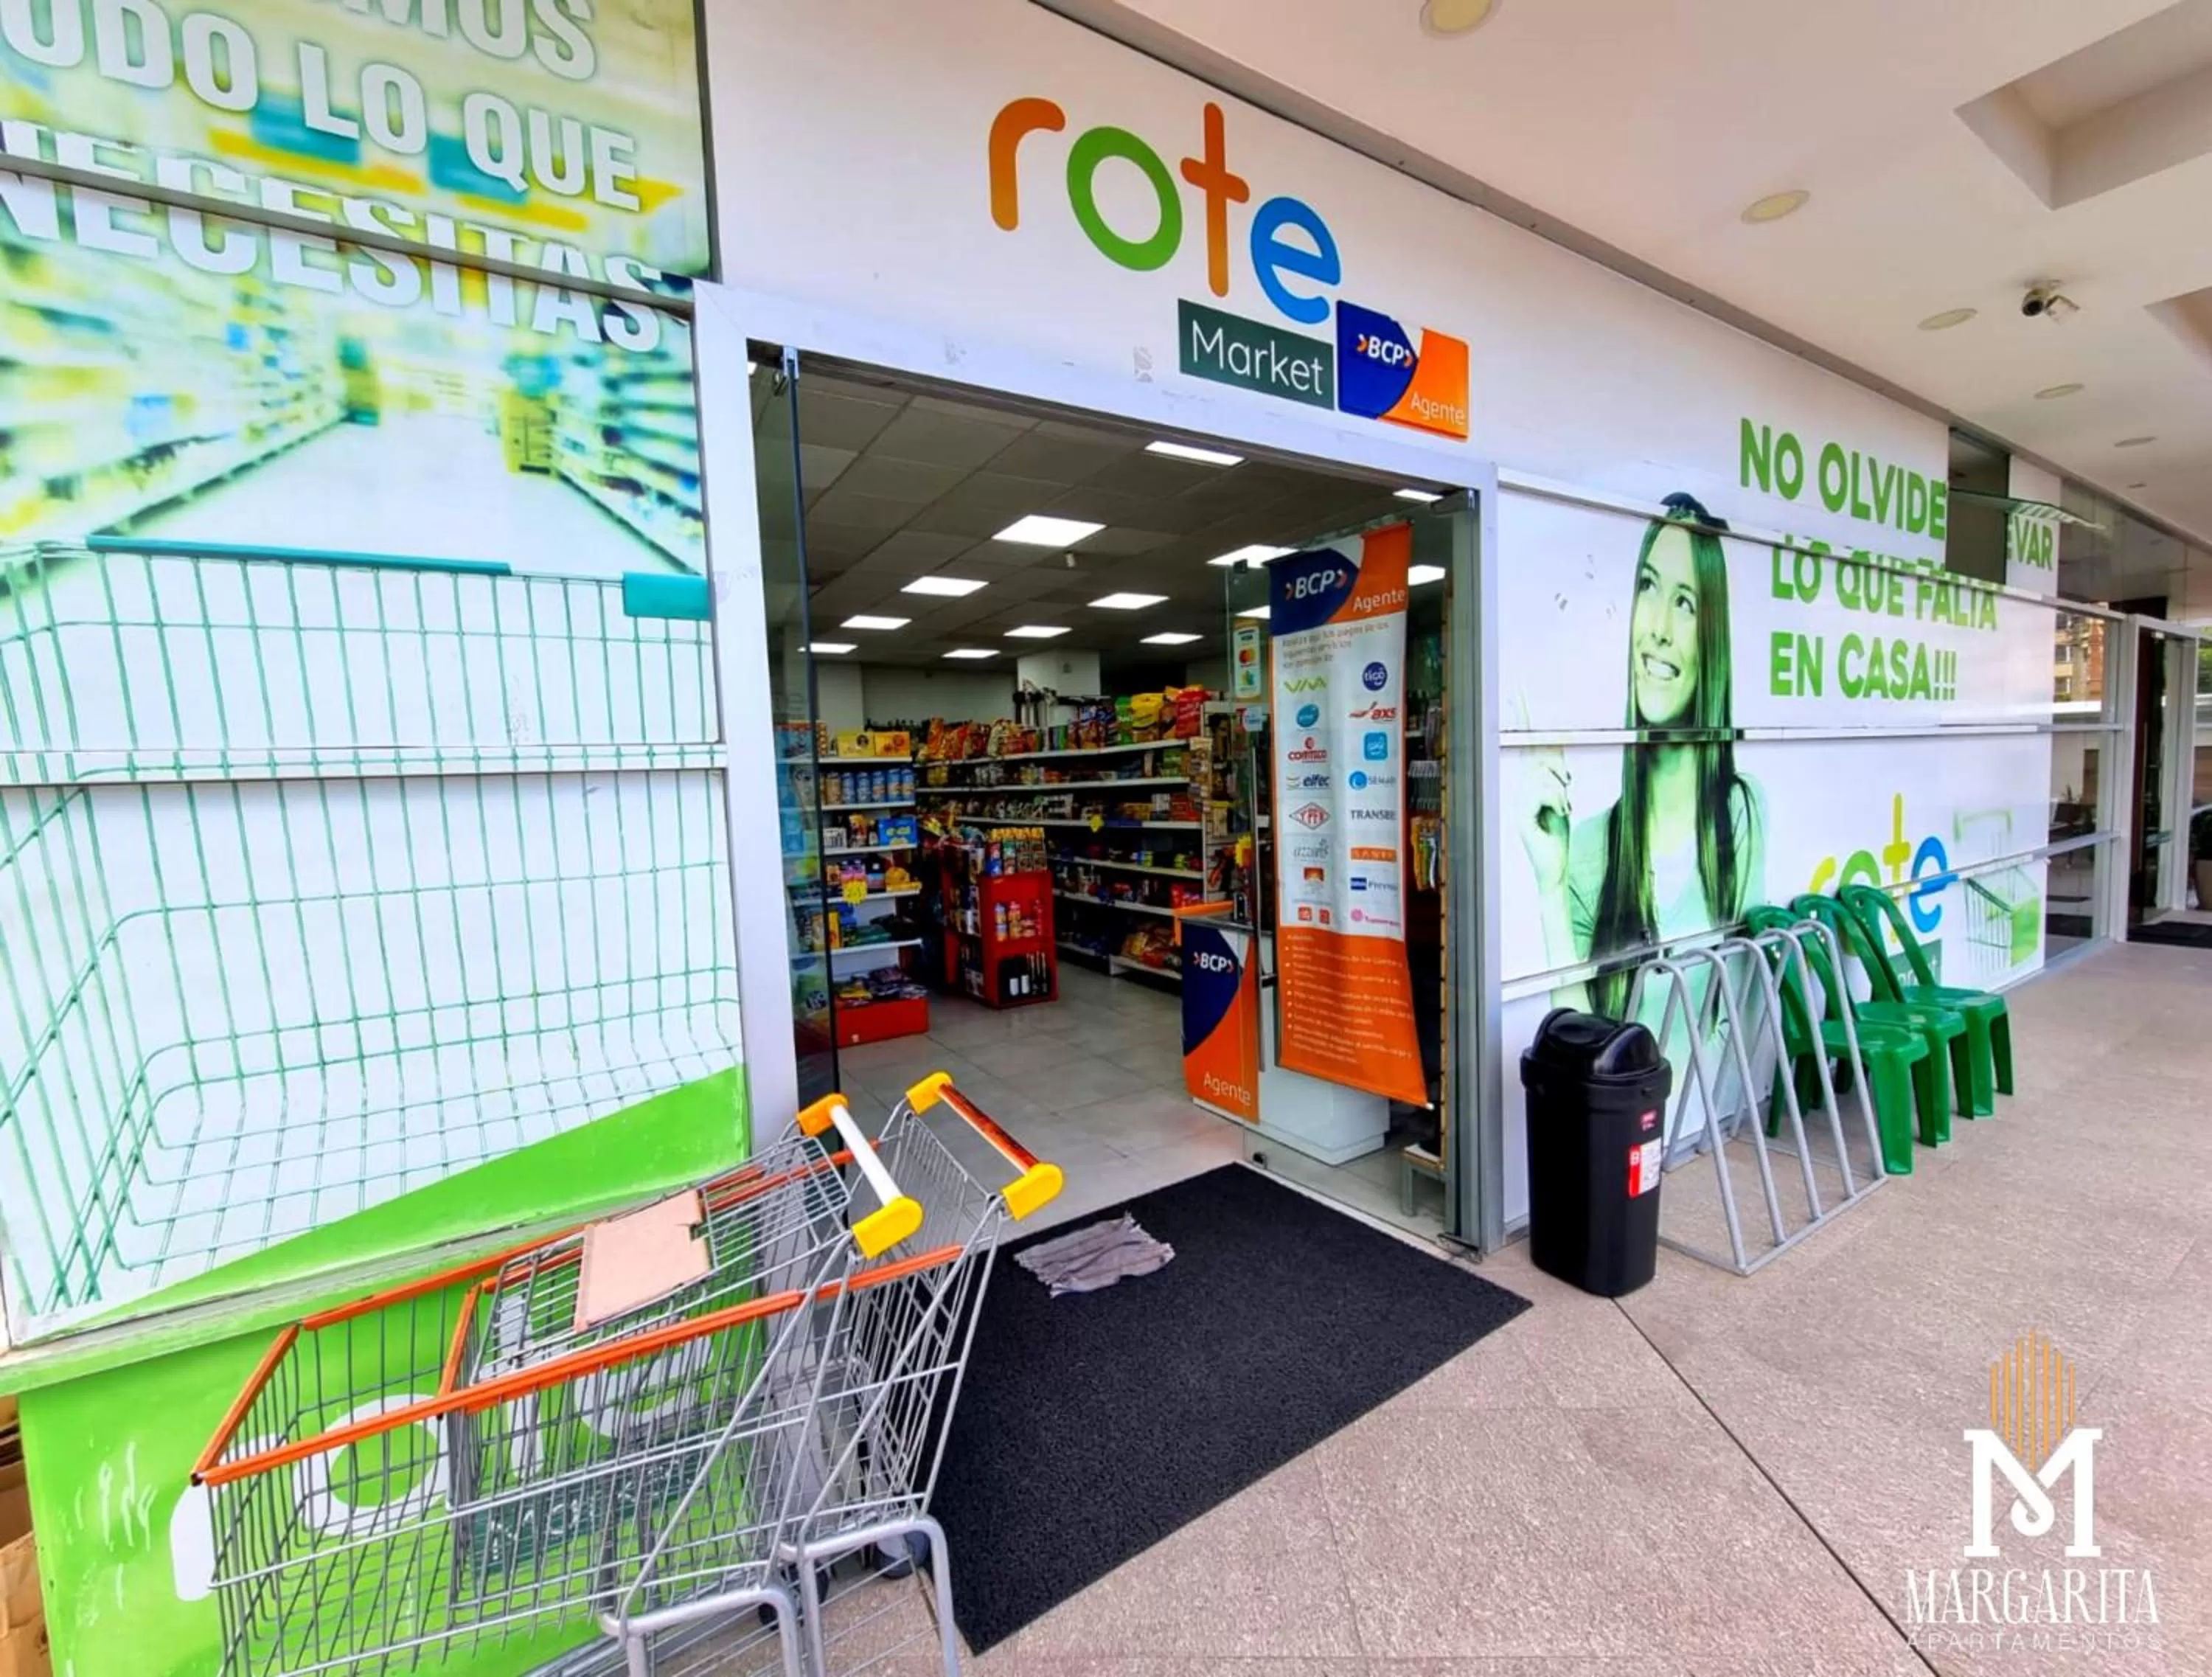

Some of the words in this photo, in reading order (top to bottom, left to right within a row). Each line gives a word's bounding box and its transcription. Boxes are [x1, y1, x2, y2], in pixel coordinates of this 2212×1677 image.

[299, 41, 428, 155] LO
[462, 94, 641, 211] QUE
[0, 119, 663, 353] NECESITAS
[989, 97, 1342, 324] rote
[1192, 319, 1324, 396] Market
[1368, 336, 1406, 367] BCP
[1411, 392, 1466, 427] Agente
[1740, 417, 1804, 501] NO
[1818, 442, 1947, 541] OLVIDE
[1295, 569, 1335, 599] BCP
[1352, 589, 1405, 613] Agente
[1772, 534, 1830, 604] LO
[1835, 550, 1911, 617] QUE
[1771, 631, 1823, 697] EN
[1839, 632, 1956, 701] CASA!!!
[1200, 951, 1228, 973] BCP
[1203, 1073, 1252, 1107] Agente
